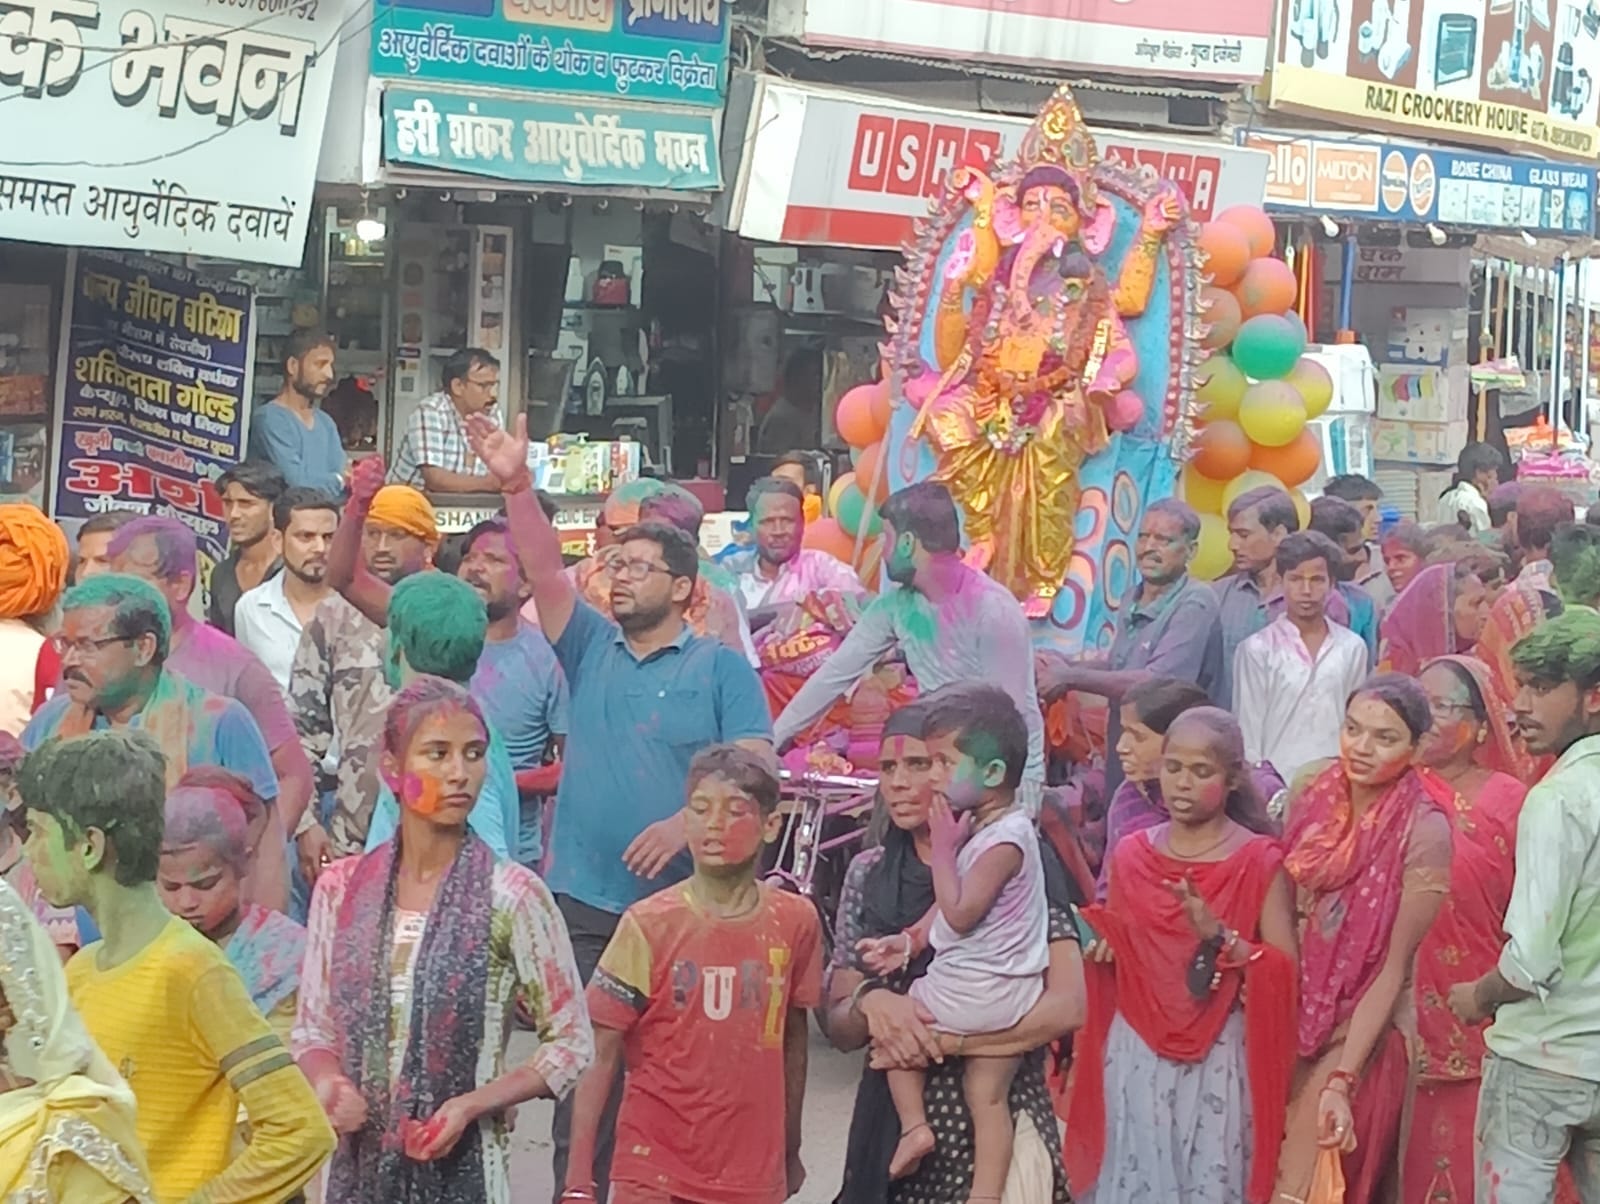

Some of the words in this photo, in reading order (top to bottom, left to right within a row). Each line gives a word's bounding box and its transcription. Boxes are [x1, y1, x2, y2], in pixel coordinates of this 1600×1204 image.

[110, 8, 316, 137] भवन
[474, 33, 530, 70] दवाओं
[531, 36, 551, 71] के
[554, 39, 592, 75] थोक
[593, 52, 609, 78] व
[667, 49, 718, 91] विक्रेता
[1365, 85, 1398, 114] RAZI
[1402, 92, 1482, 126] CROCKERY
[393, 99, 441, 157] हरी
[446, 102, 514, 162] शंकर
[654, 130, 710, 174] भवन
[1266, 144, 1306, 186] ello
[1317, 160, 1373, 181] MILTON
[226, 195, 297, 243] दवायें
[176, 378, 238, 423] गोल्ड
[435, 511, 494, 527] SHAN
